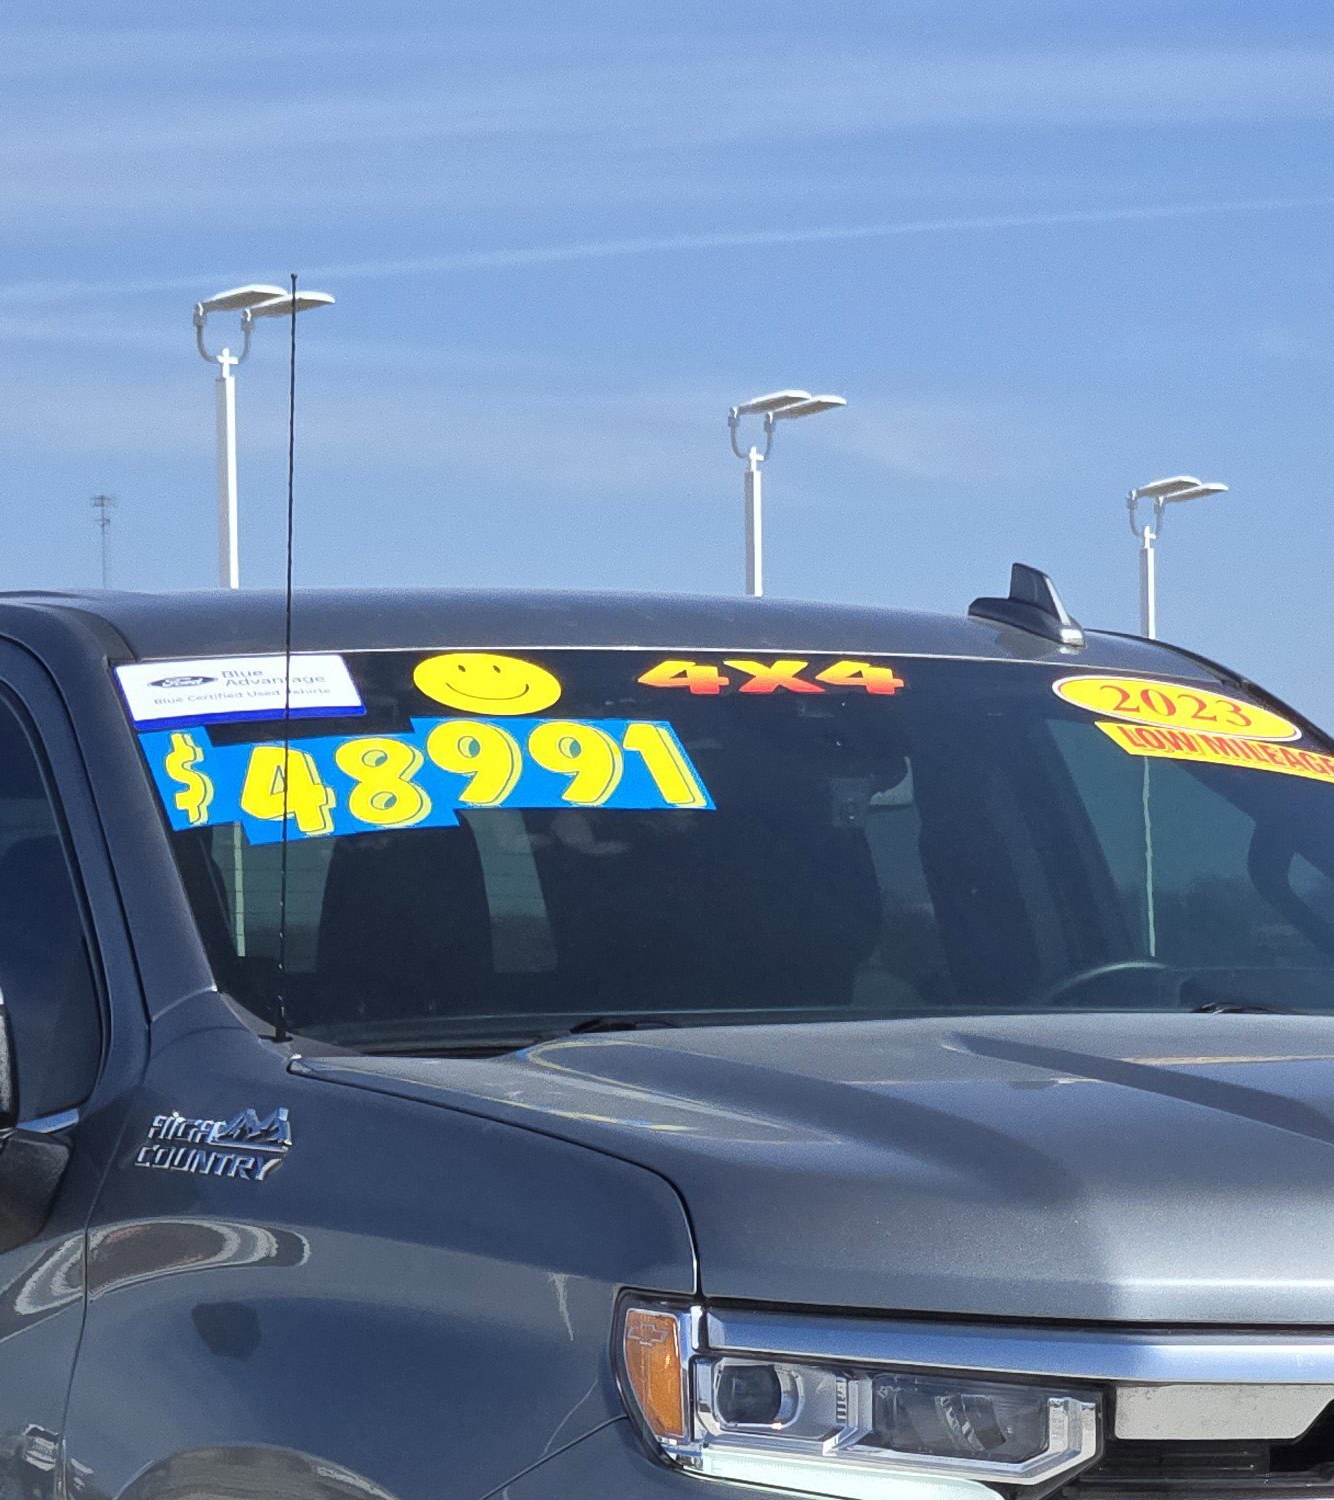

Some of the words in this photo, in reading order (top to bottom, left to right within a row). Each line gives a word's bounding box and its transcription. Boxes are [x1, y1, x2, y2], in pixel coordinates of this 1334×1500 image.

[221, 670, 263, 678] Blue
[637, 660, 905, 695] 4X4
[1098, 685, 1252, 727] 2023
[1116, 725, 1199, 751] LOW
[148, 1111, 227, 1144] HIGH
[135, 1144, 282, 1182] COUNTRY
